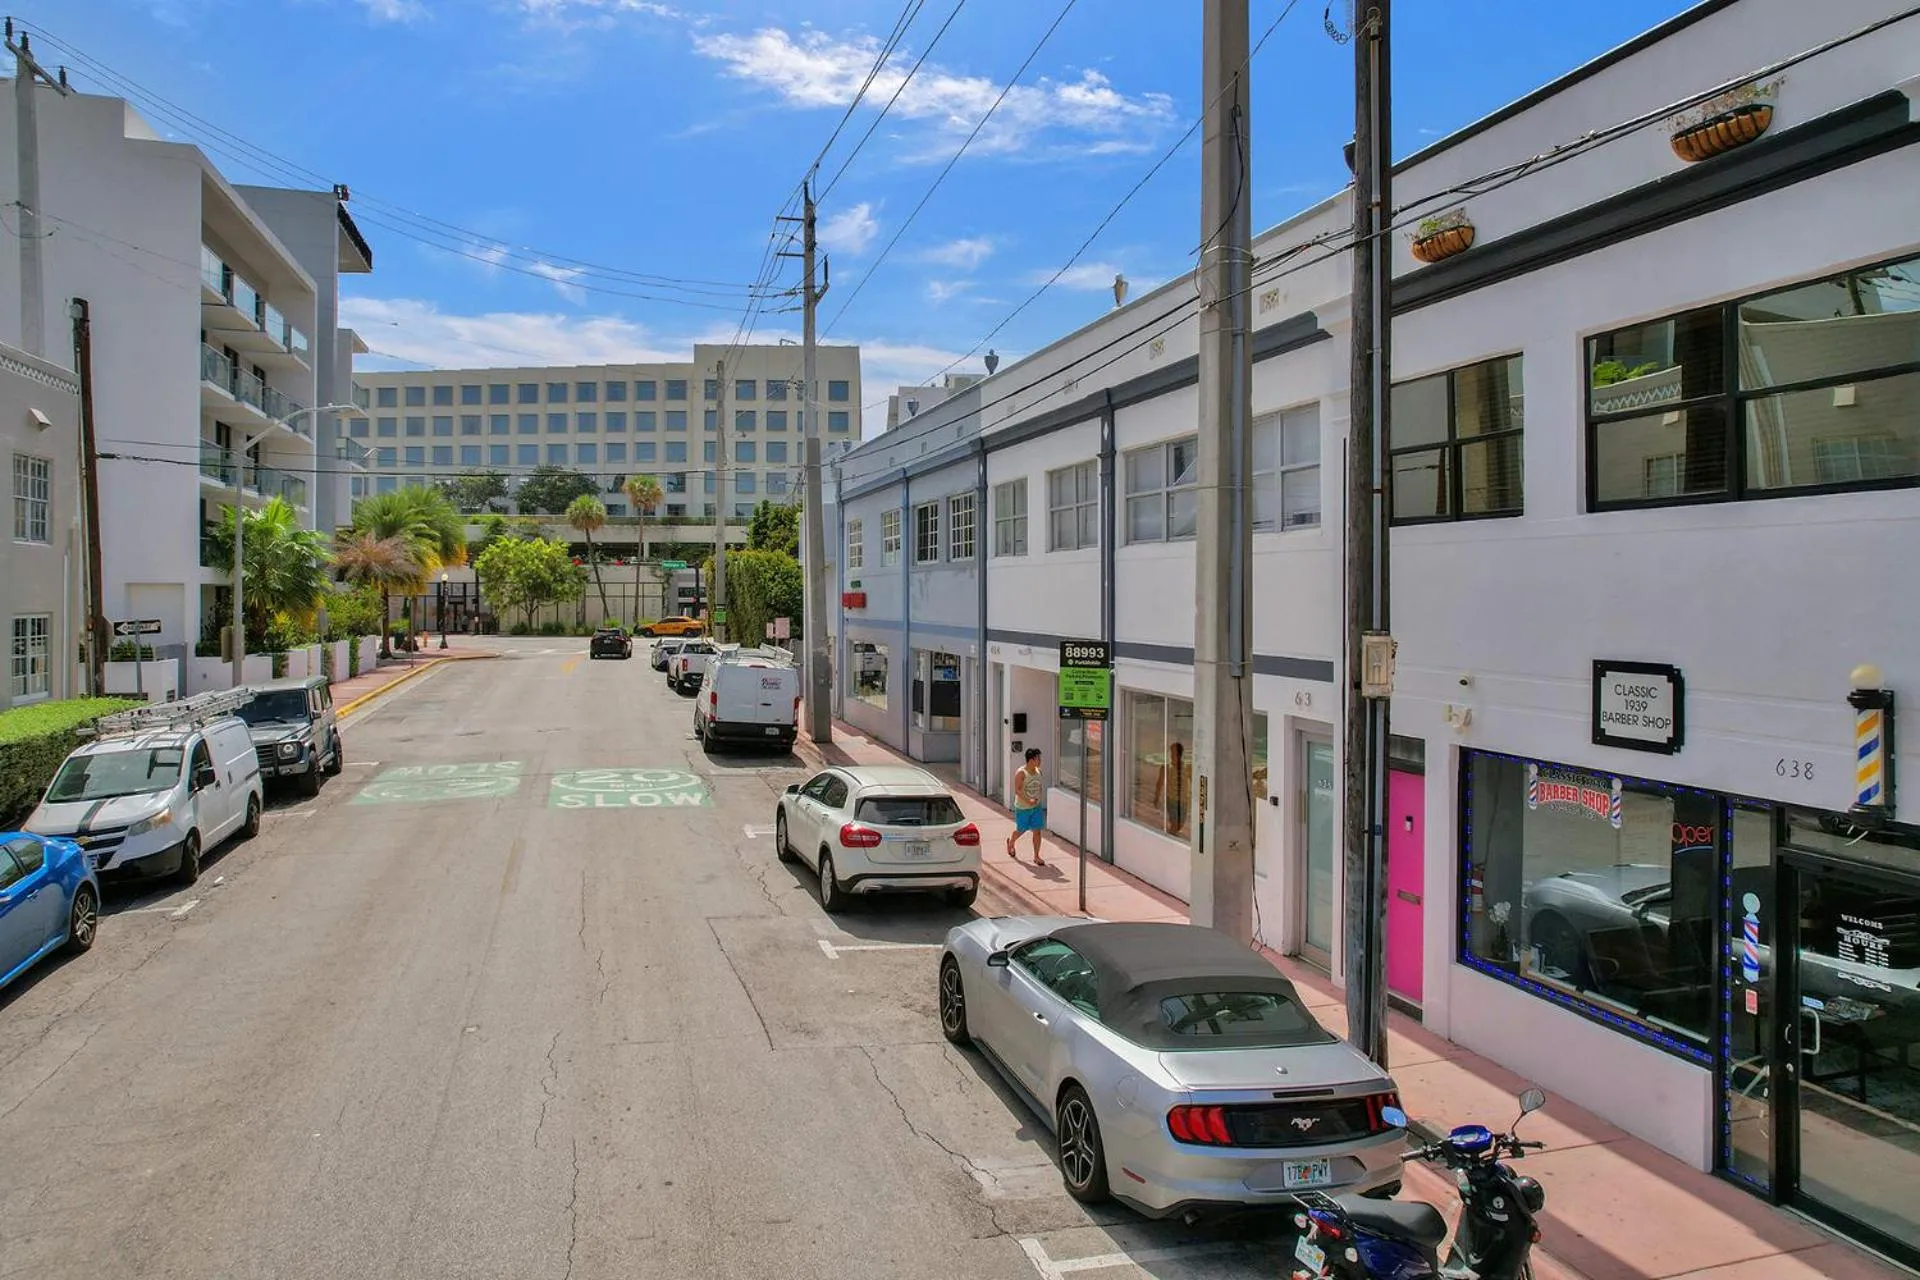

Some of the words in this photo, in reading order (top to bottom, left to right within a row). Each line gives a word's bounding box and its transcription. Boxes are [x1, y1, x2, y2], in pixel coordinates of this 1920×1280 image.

[1065, 647, 1104, 658] 88993
[1614, 684, 1658, 699] CLASSIC
[1624, 698, 1648, 712] 1939
[1602, 711, 1640, 726] BARBER
[1642, 715, 1671, 729] SHOP
[576, 770, 681, 784] 20
[1776, 758, 1814, 780] 638
[556, 792, 703, 809] SLOW
[1539, 782, 1579, 803] BARBER
[1581, 788, 1610, 818] SHOP
[1841, 914, 1883, 930] WELCOME
[1844, 934, 1883, 951] HOURS
